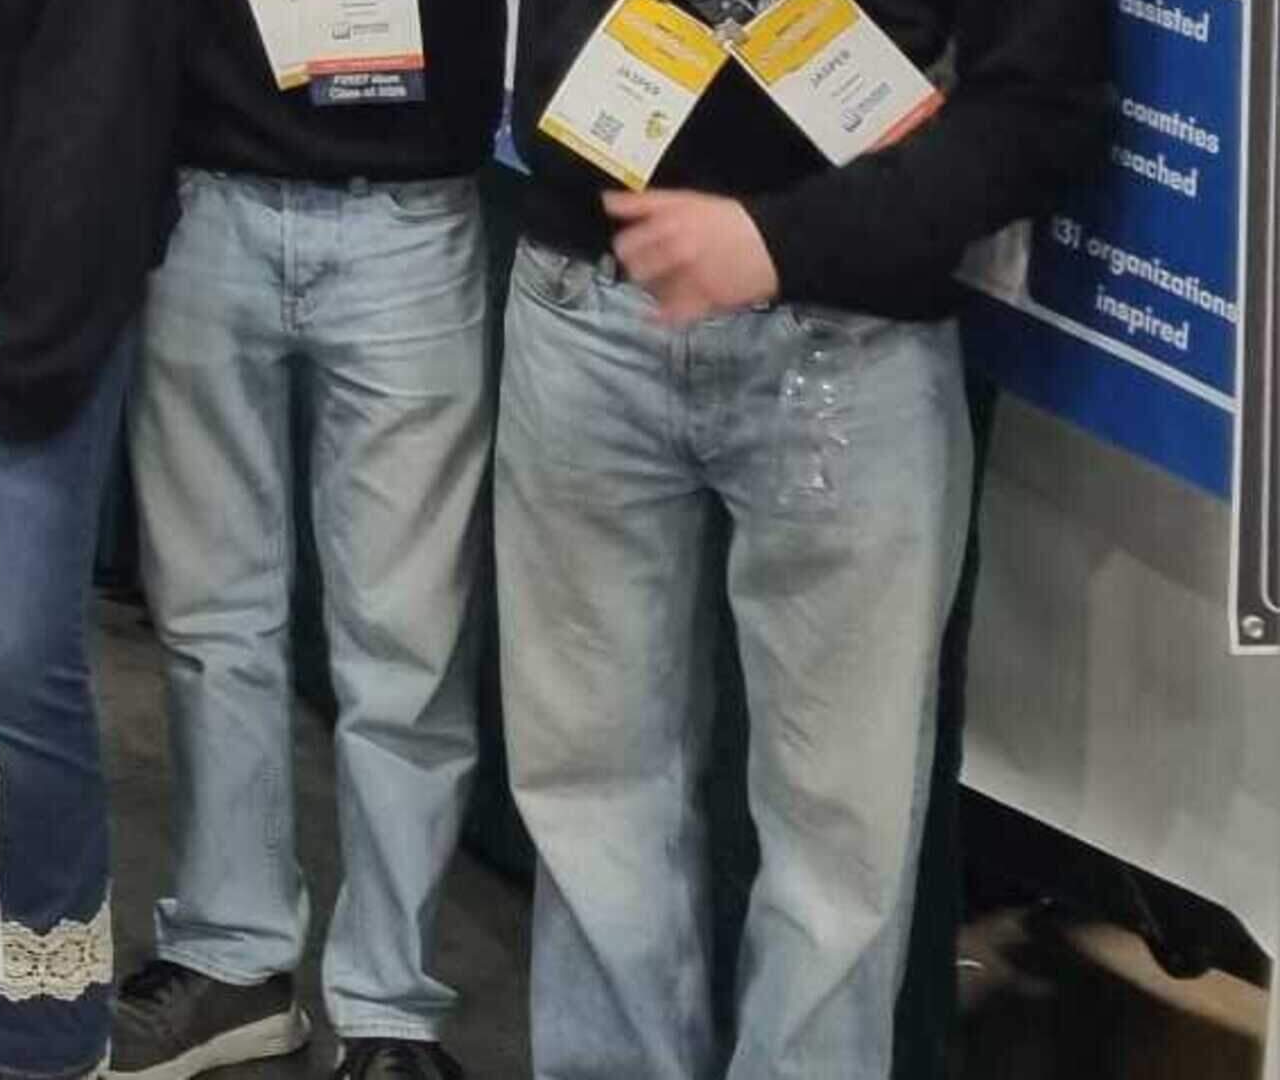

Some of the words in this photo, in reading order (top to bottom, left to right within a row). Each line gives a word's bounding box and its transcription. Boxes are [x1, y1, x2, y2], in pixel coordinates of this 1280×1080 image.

[1121, 95, 1220, 155] countries
[1112, 143, 1198, 199] reached
[1087, 236, 1241, 326] organizations
[1095, 283, 1190, 351] inspired
